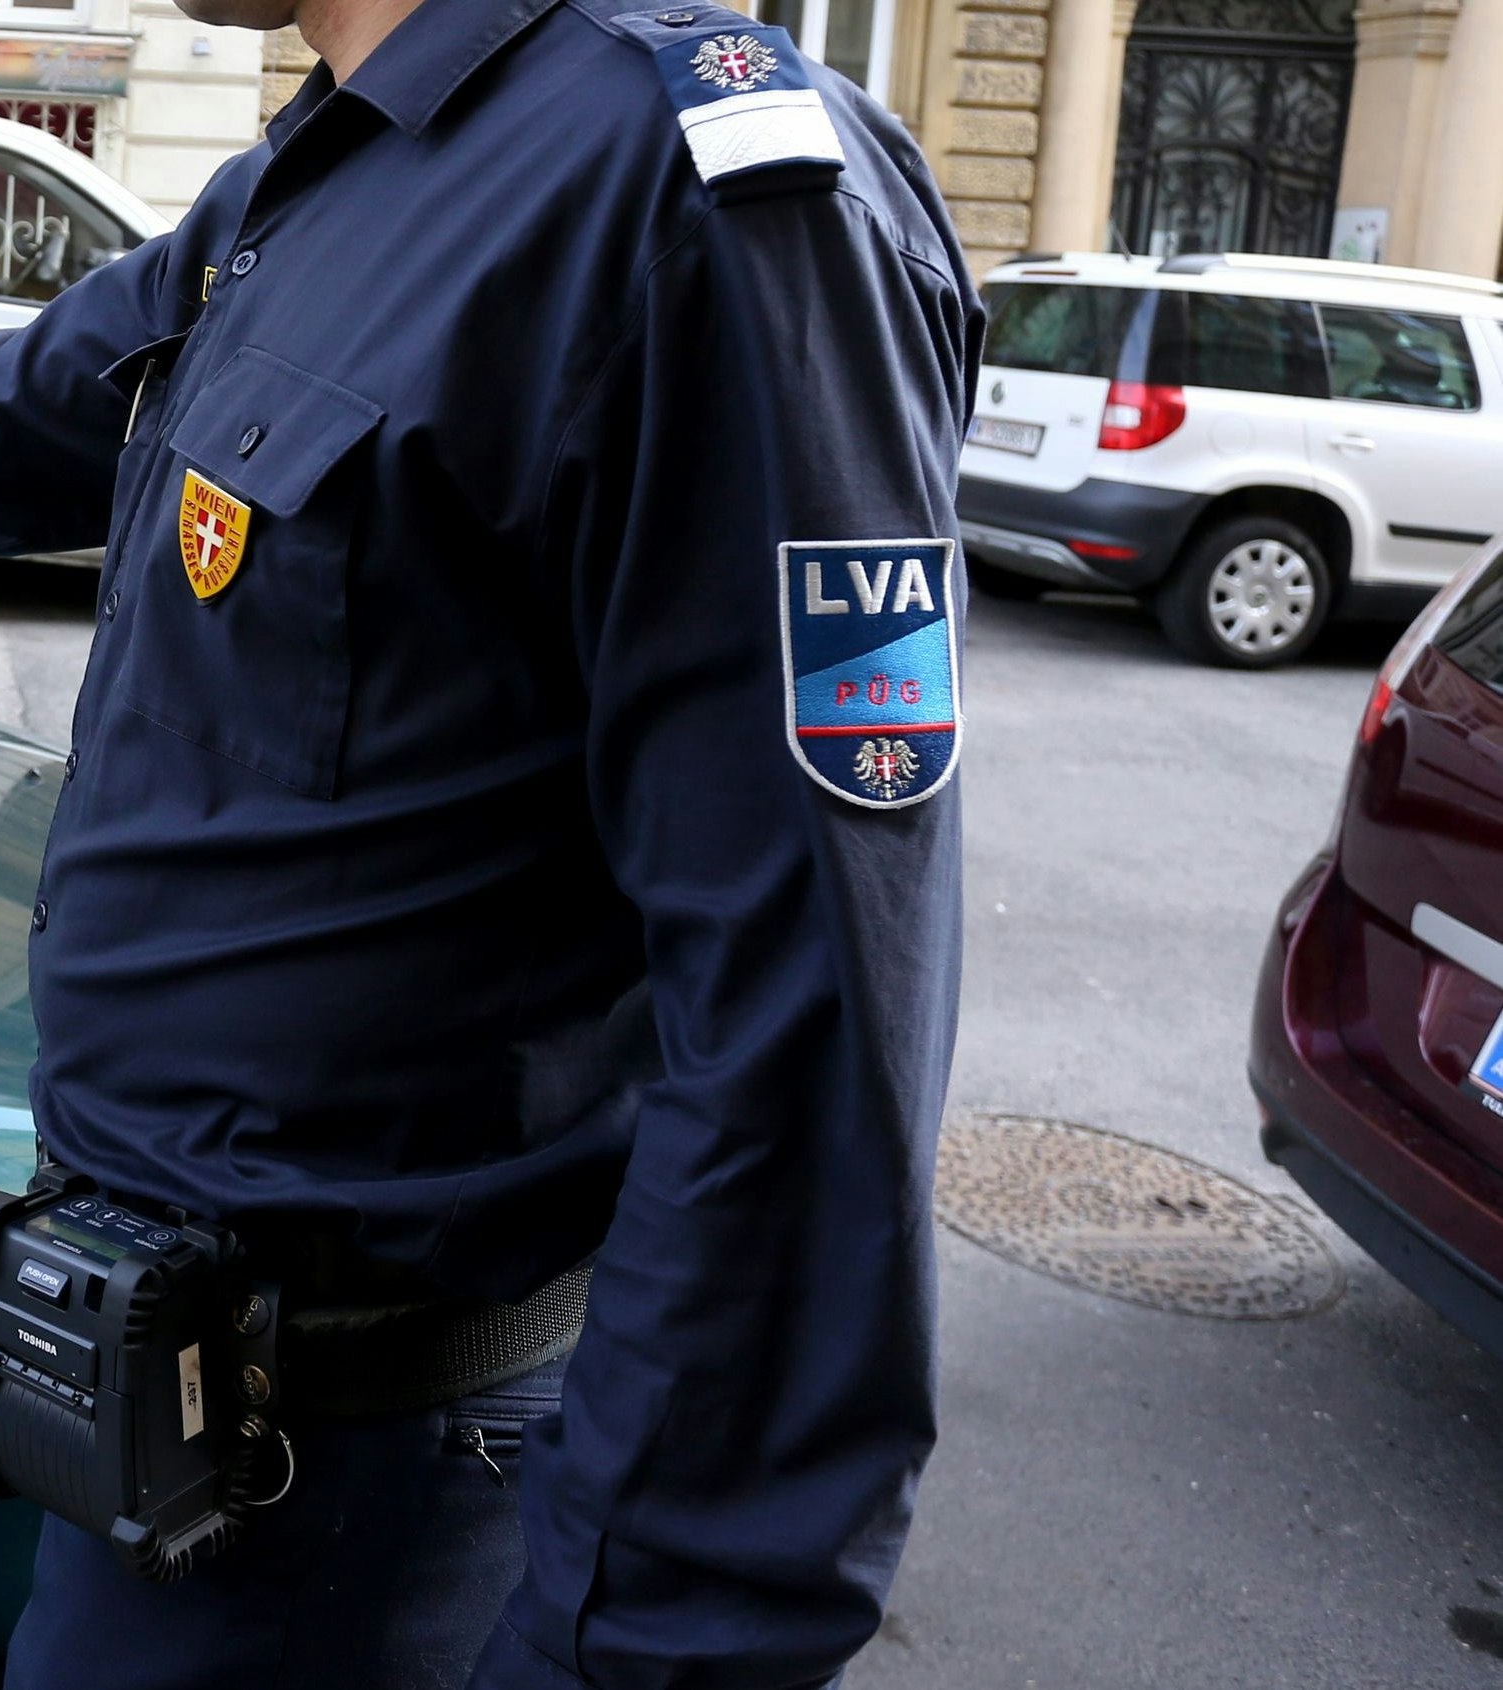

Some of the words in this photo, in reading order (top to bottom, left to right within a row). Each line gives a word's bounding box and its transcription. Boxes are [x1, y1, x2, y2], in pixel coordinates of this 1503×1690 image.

[195, 483, 237, 523] WIEN
[805, 559, 935, 615] LVA
[836, 674, 921, 706] PÜG
[134, 1238, 159, 1250] POWER
[25, 1265, 42, 1279] PUSH
[41, 1273, 60, 1286] OPEN
[18, 1328, 57, 1356] TOSHIBA
